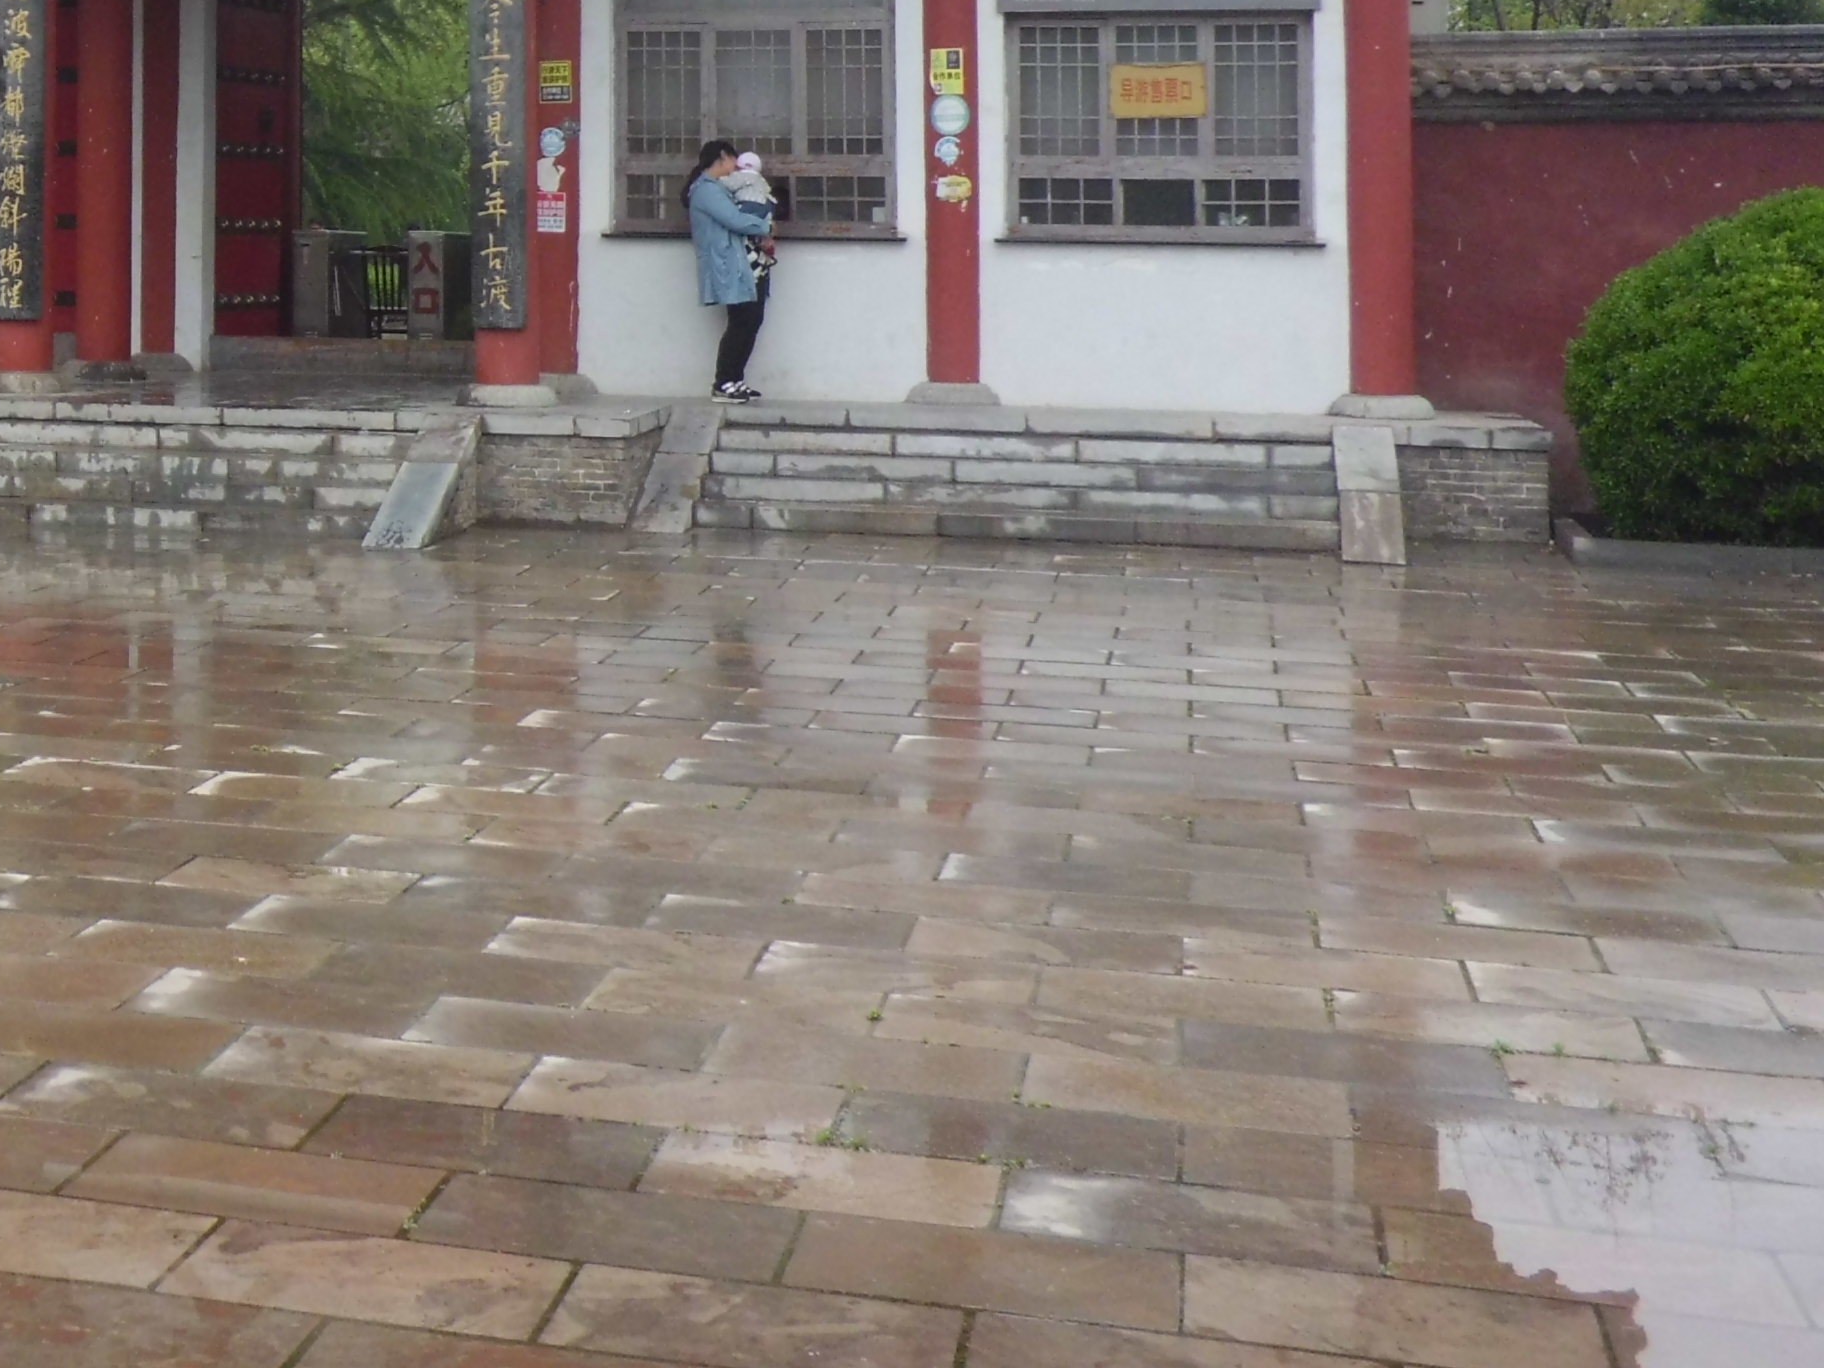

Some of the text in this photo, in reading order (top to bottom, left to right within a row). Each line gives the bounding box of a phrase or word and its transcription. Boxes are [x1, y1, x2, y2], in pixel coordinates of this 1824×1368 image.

[1120, 77, 1192, 104] 导游售票口
[412, 241, 441, 314] 入口
